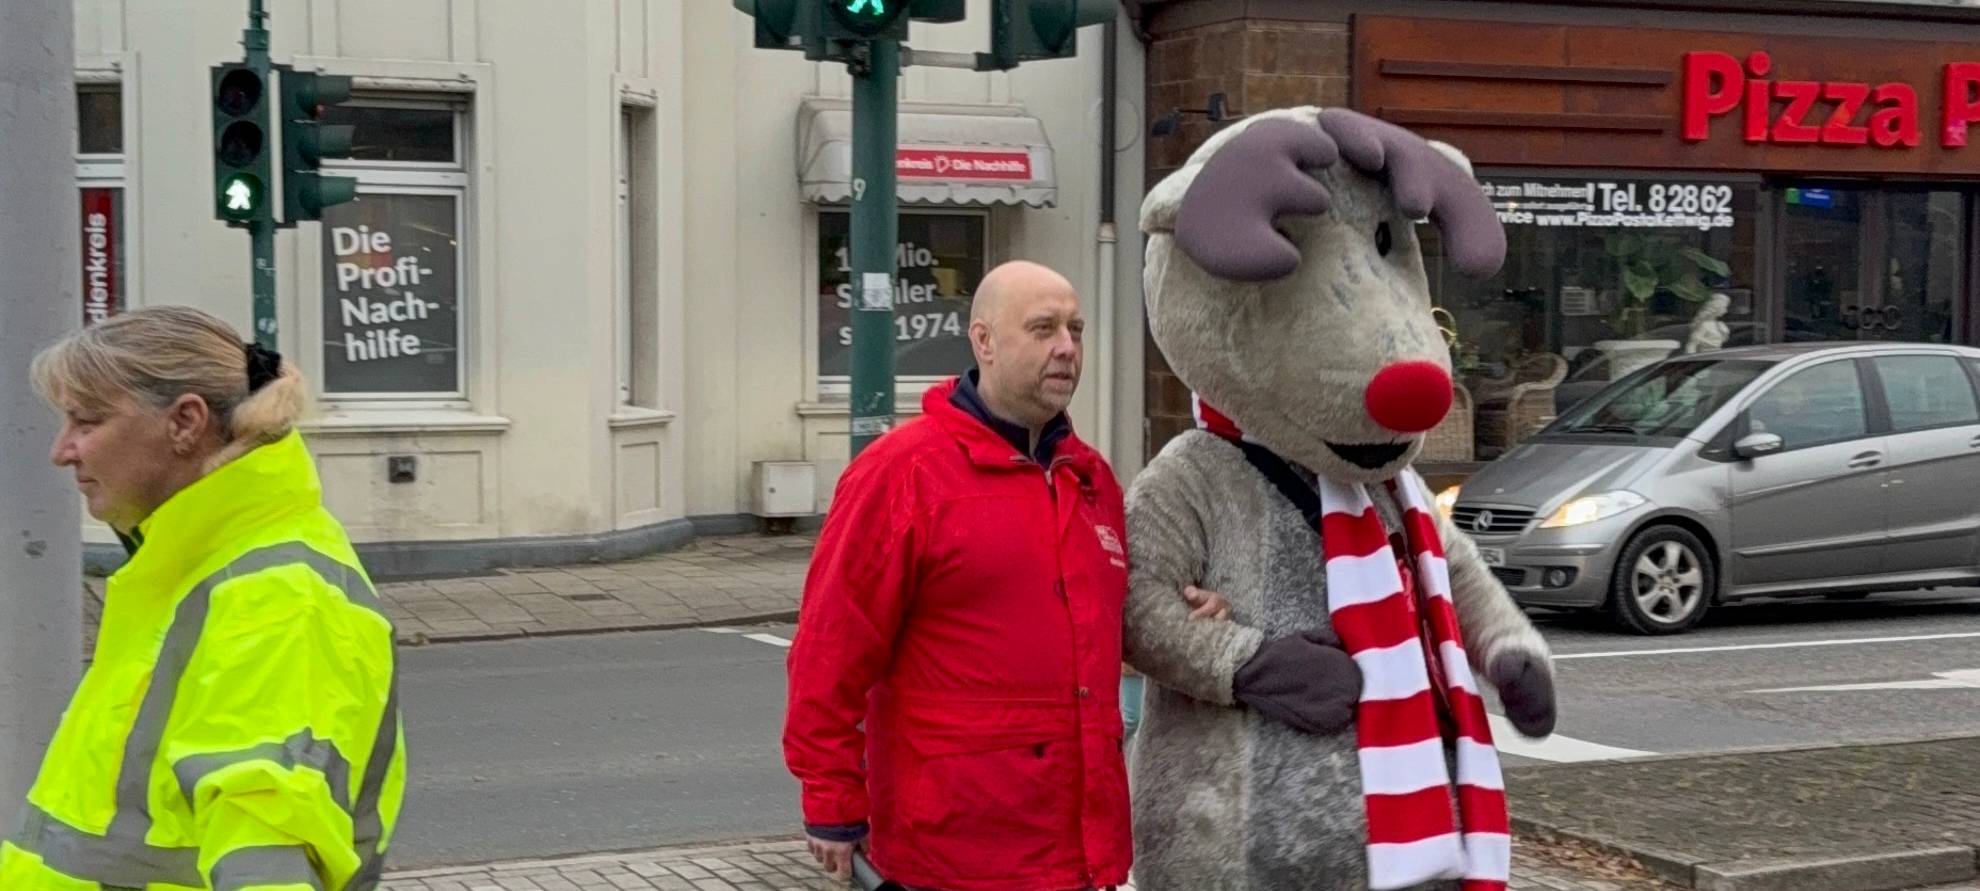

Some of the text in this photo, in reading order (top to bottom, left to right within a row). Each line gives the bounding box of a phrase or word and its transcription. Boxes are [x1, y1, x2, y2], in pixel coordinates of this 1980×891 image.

[1682, 50, 1980, 149] Pizza P
[953, 160, 972, 171] Die
[974, 160, 1027, 172] Nachhilfe
[853, 178, 866, 201] 9
[1496, 185, 1522, 197] zum
[1597, 183, 1733, 213] Tel. 82862
[331, 224, 392, 256] Die
[336, 255, 432, 291] Profi-
[340, 291, 439, 327] Nach-
[895, 312, 960, 340] 1974
[344, 328, 421, 362] hilfe
